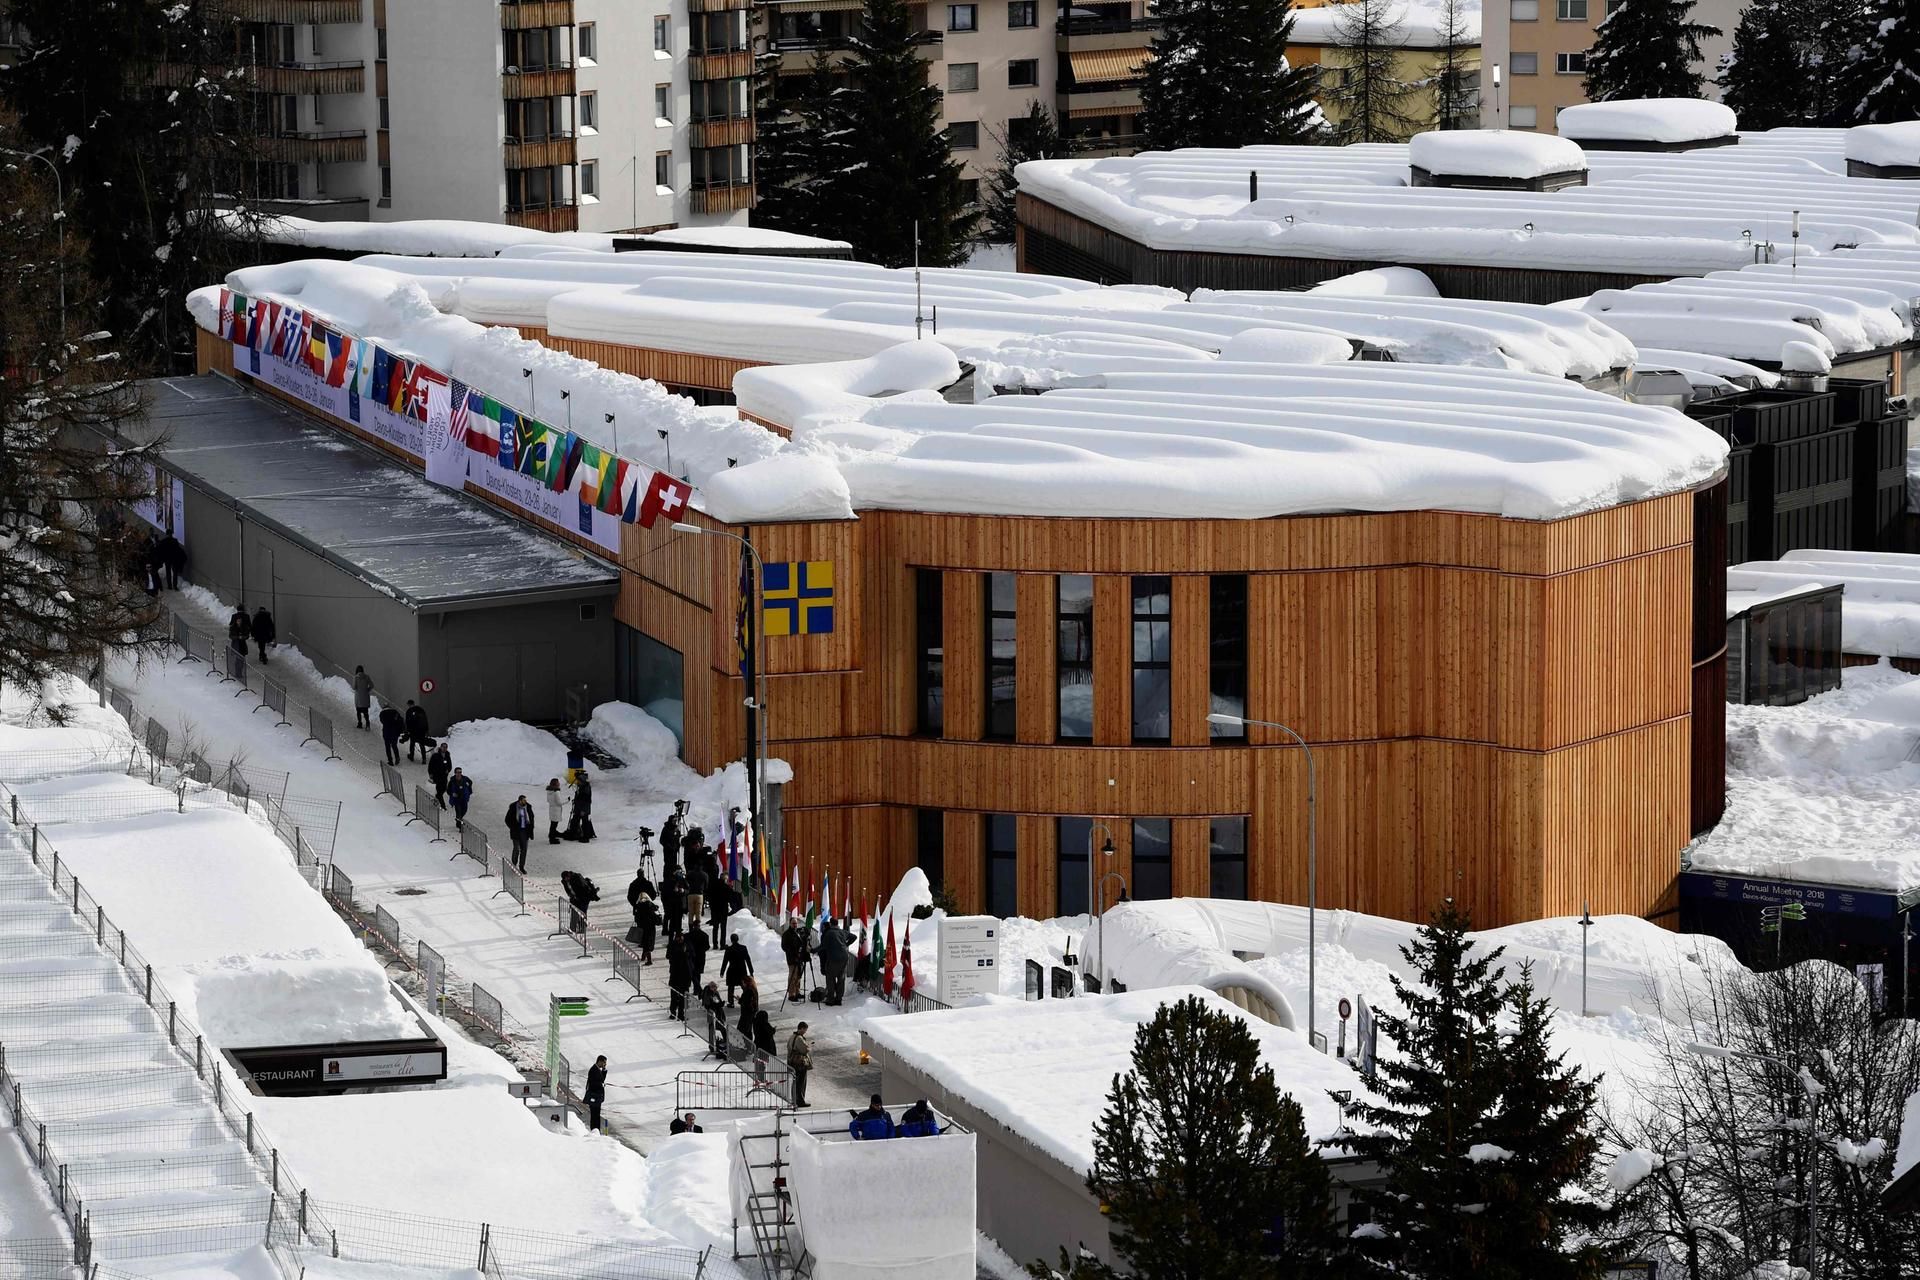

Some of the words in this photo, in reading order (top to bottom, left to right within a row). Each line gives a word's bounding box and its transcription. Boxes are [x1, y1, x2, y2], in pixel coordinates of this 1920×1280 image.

[524, 488, 540, 511] 23-26
[543, 497, 562, 524] January
[1743, 882, 1769, 893] Annual
[1772, 886, 1803, 898] Meeting
[1806, 890, 1825, 899] 2018
[1804, 900, 1825, 909] January
[250, 1069, 316, 1081] ESTAURANT
